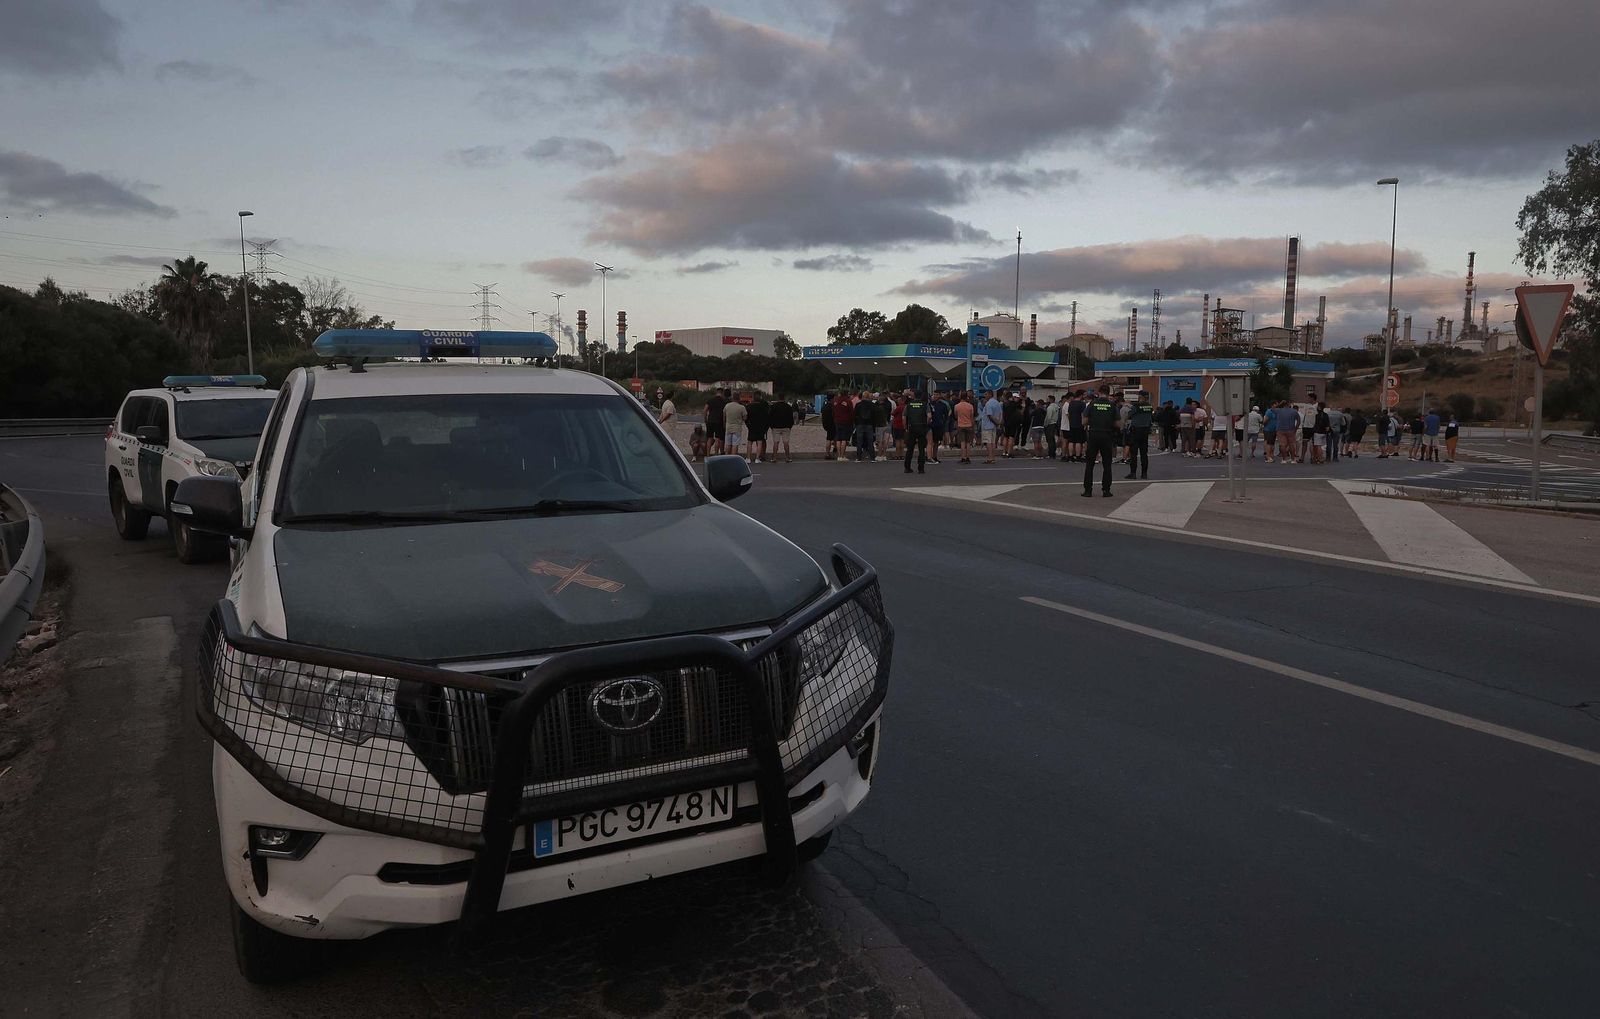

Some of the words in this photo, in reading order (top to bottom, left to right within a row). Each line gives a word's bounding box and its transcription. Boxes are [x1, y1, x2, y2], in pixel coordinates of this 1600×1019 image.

[434, 337, 466, 345] CIVIL
[558, 808, 618, 847] PGC
[626, 793, 704, 832] 9748
[711, 787, 728, 817] N
[540, 839, 548, 849] E
